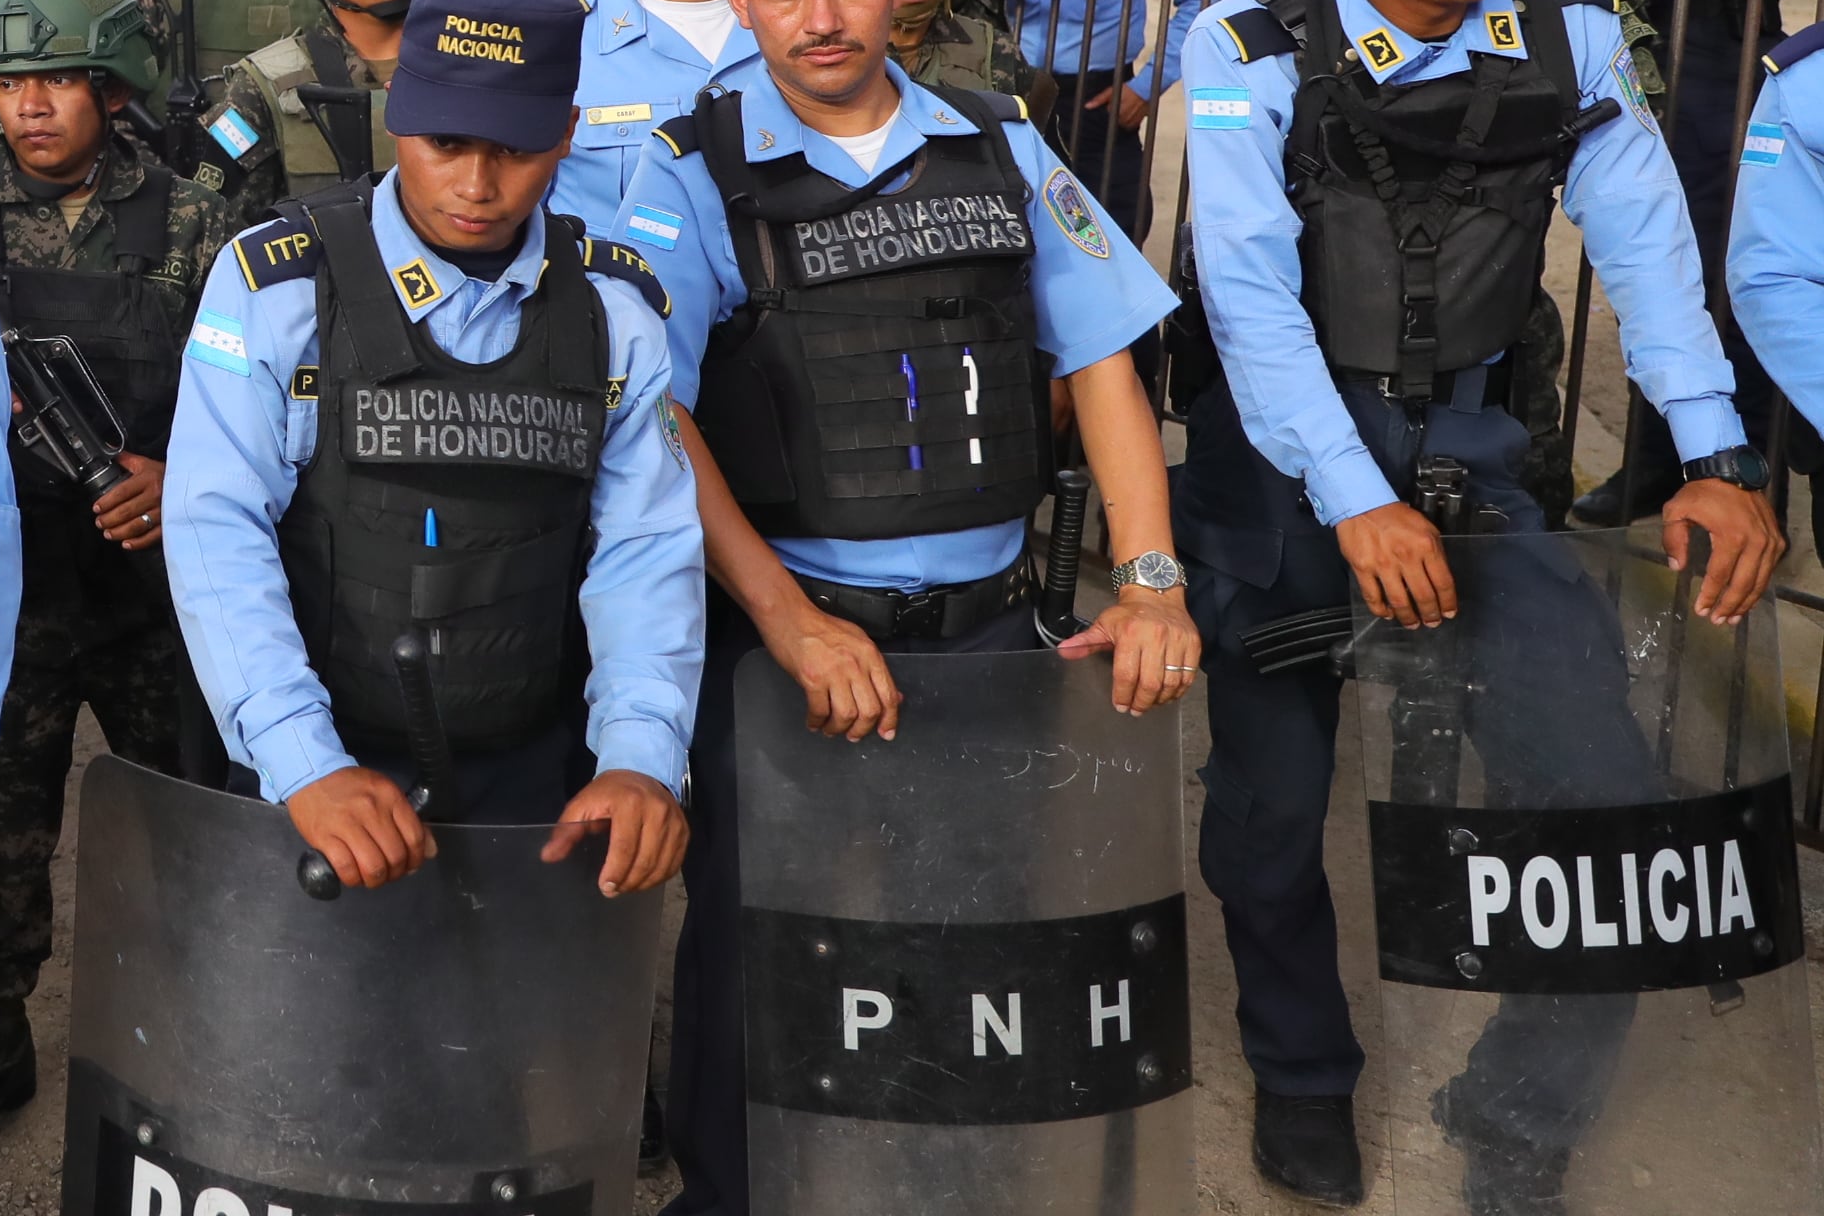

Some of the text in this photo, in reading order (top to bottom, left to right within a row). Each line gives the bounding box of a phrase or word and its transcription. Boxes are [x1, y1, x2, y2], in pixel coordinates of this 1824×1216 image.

[437, 34, 525, 64] NACIONAL
[445, 15, 523, 43] POLICIA
[795, 195, 1017, 248] POLICIA NACIONAL
[263, 233, 311, 265] ITP
[802, 221, 1027, 278] DE HONDURAS
[356, 389, 588, 435] POLICIA NACIONAL
[356, 424, 588, 470] DE HONDURAS
[1467, 839, 1756, 949] POLICIA
